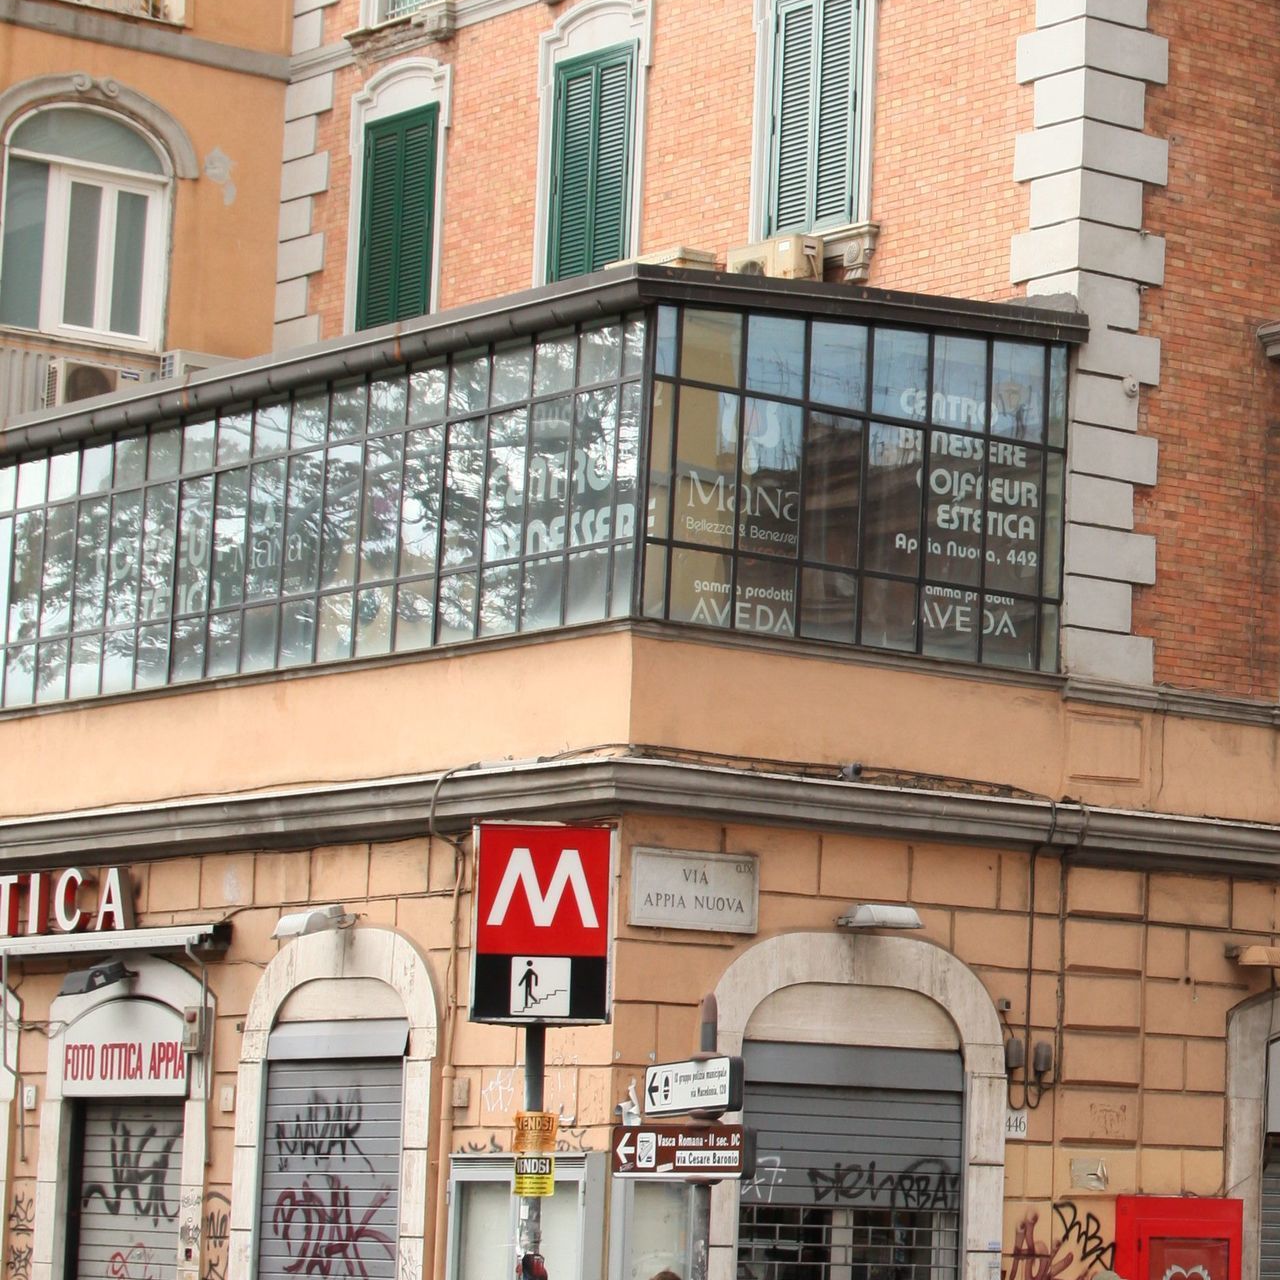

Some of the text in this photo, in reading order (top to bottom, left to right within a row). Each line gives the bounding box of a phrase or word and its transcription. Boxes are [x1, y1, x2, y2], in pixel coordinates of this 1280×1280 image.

[895, 533, 1038, 568] Apia Nuoa, 442
[745, 585, 794, 603] prodotti
[925, 585, 961, 599] amma
[683, 868, 709, 885] VIA
[485, 847, 600, 928] M
[644, 893, 745, 913] APPIA NUOVA
[64, 1041, 185, 1081] FOTO OTTICA APPIA
[1005, 1115, 1027, 1132] 446
[657, 1133, 676, 1147] Vasca
[678, 1133, 704, 1147] Romana
[715, 1135, 729, 1147] sec.
[731, 1133, 741, 1146] DC
[677, 1152, 738, 1164] via Cesare Baronio
